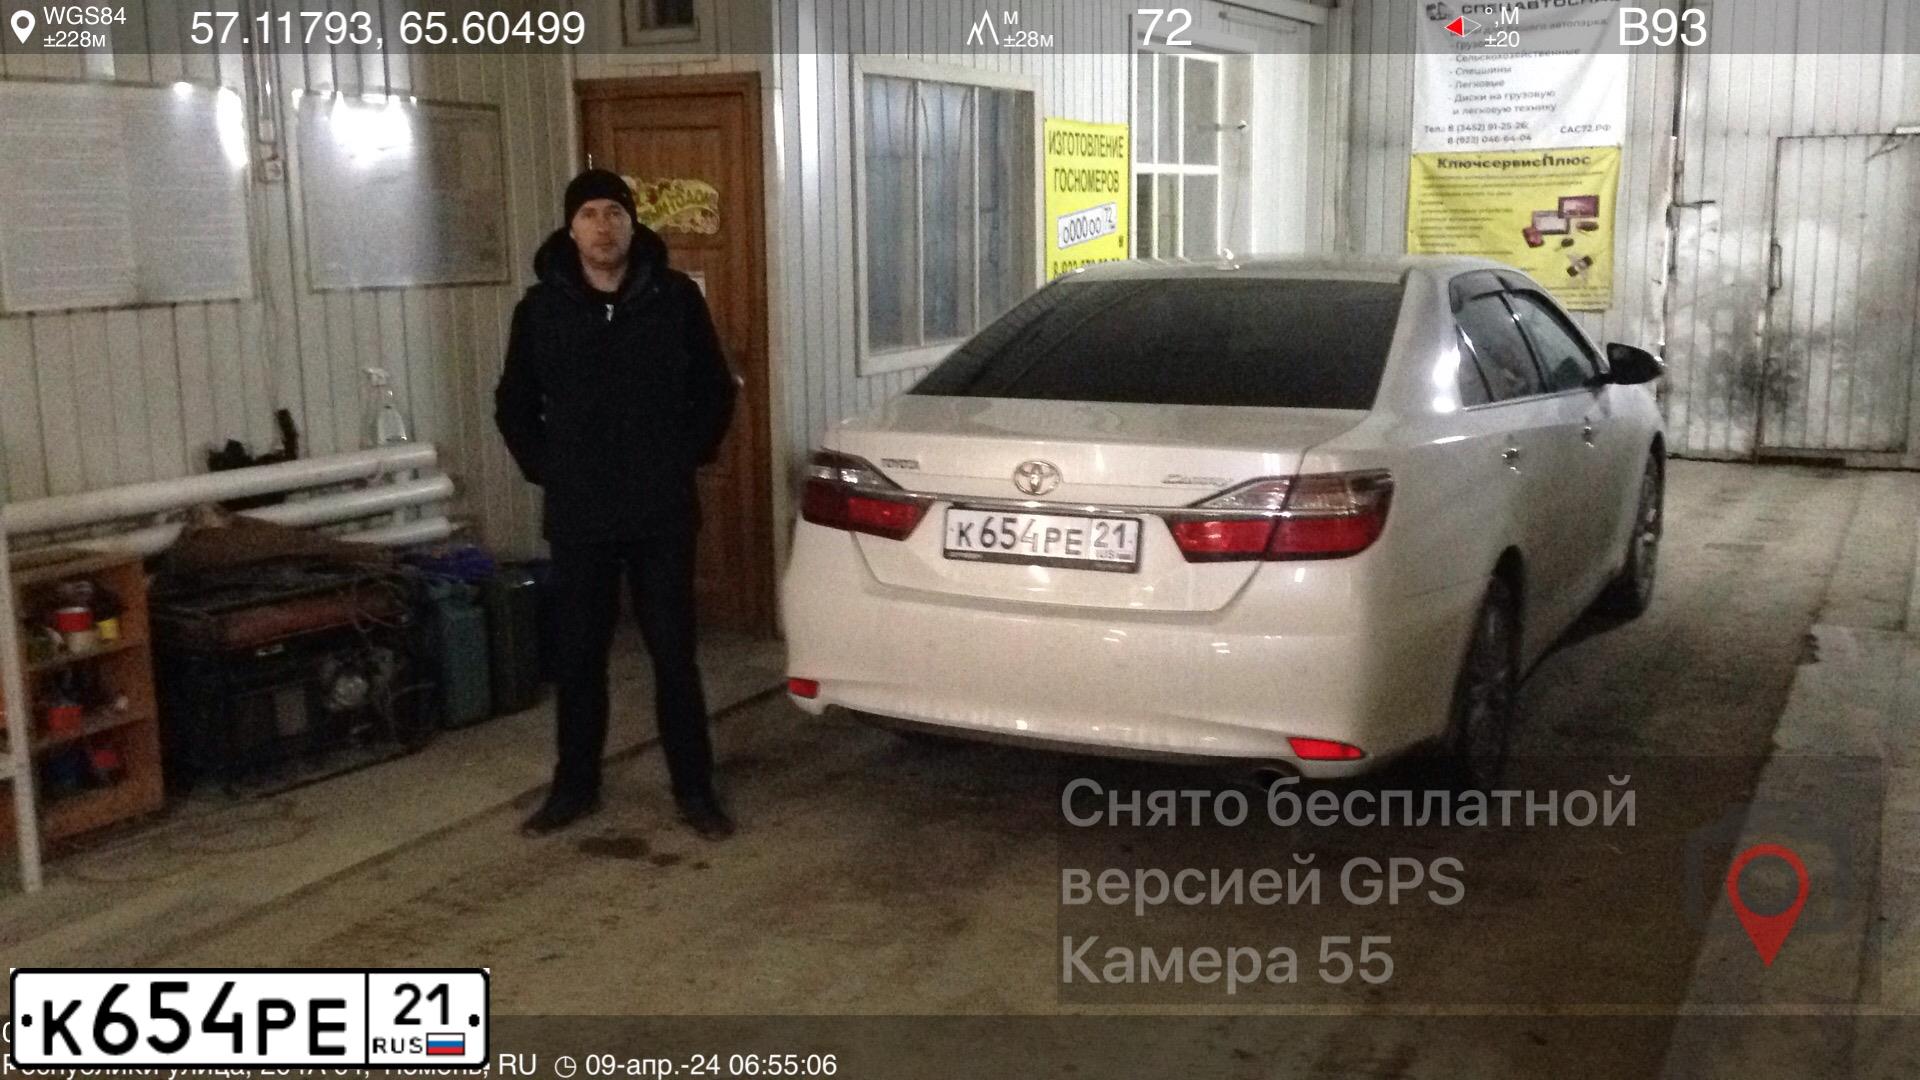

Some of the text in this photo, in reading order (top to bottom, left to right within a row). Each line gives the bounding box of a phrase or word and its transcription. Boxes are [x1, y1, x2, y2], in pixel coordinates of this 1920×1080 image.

[1048, 130, 1124, 159] ИЗГОТОВЛЕНИЕ
[1437, 153, 1592, 170] КлючсервисПлюс
[1053, 168, 1120, 193] ГОСНОМЕРОВ
[957, 516, 1126, 555] К654РЕ 21
